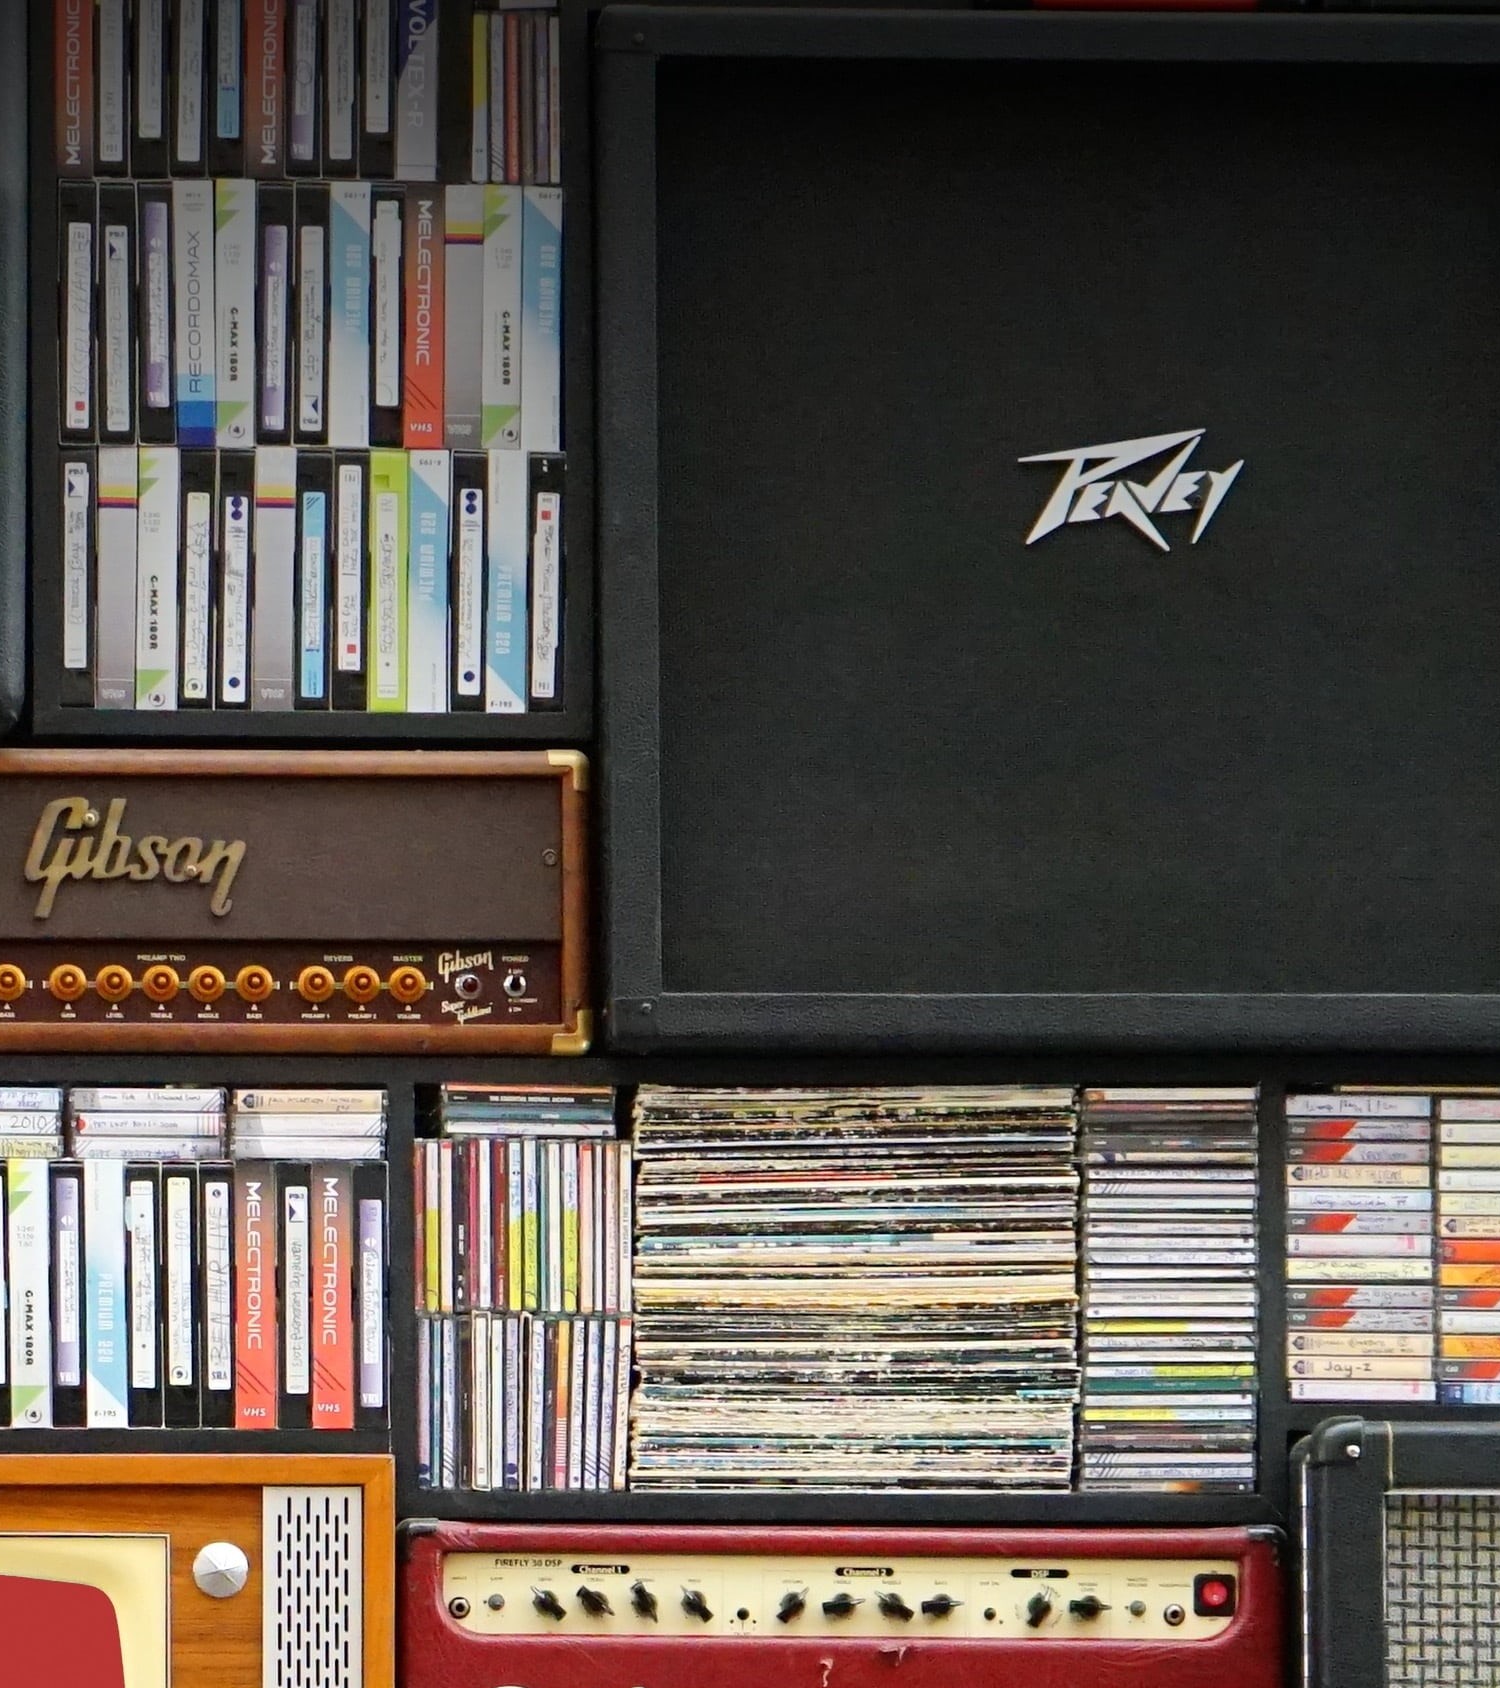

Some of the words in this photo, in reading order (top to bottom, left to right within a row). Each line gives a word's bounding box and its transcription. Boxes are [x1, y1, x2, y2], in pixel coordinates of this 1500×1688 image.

[189, 230, 201, 394] RECORDOMAX
[416, 201, 432, 366] MELECTRONIC
[410, 423, 433, 433] VHS
[1016, 427, 1244, 552] PEAVEY
[23, 796, 246, 920] Gibson
[436, 950, 494, 977] Gibson
[246, 1182, 263, 1350] MELECTRONIC
[322, 1177, 338, 1346] MELECTRONIC
[243, 1407, 266, 1417] VHS
[317, 1404, 341, 1413] VHS
[579, 1565, 615, 1574] Channel
[843, 1568, 879, 1577] Channel
